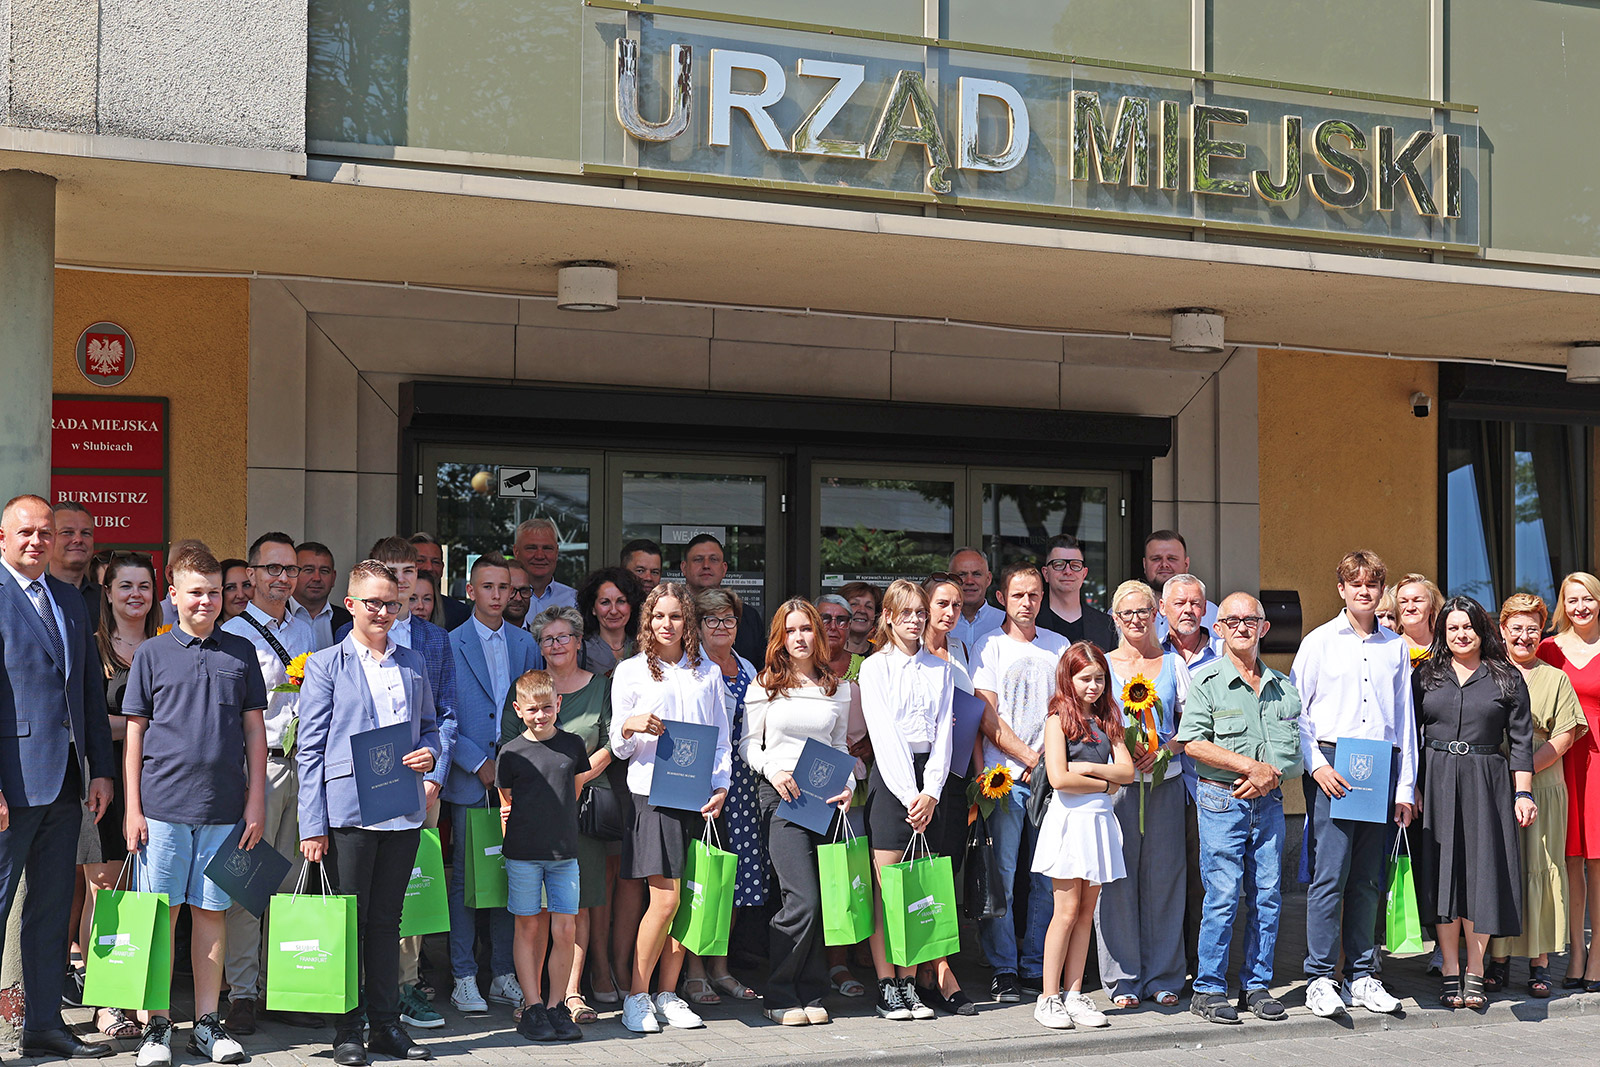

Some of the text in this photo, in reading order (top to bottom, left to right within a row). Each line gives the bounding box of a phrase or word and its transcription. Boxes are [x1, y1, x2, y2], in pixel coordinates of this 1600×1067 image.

[615, 38, 1461, 219] URZĄD MIEJSKI
[92, 419, 159, 432] MIEJSKA
[71, 443, 81, 451] w
[58, 491, 148, 504] BURMISTRZ
[94, 516, 131, 528] UBIC
[271, 640, 291, 666] HILFIG
